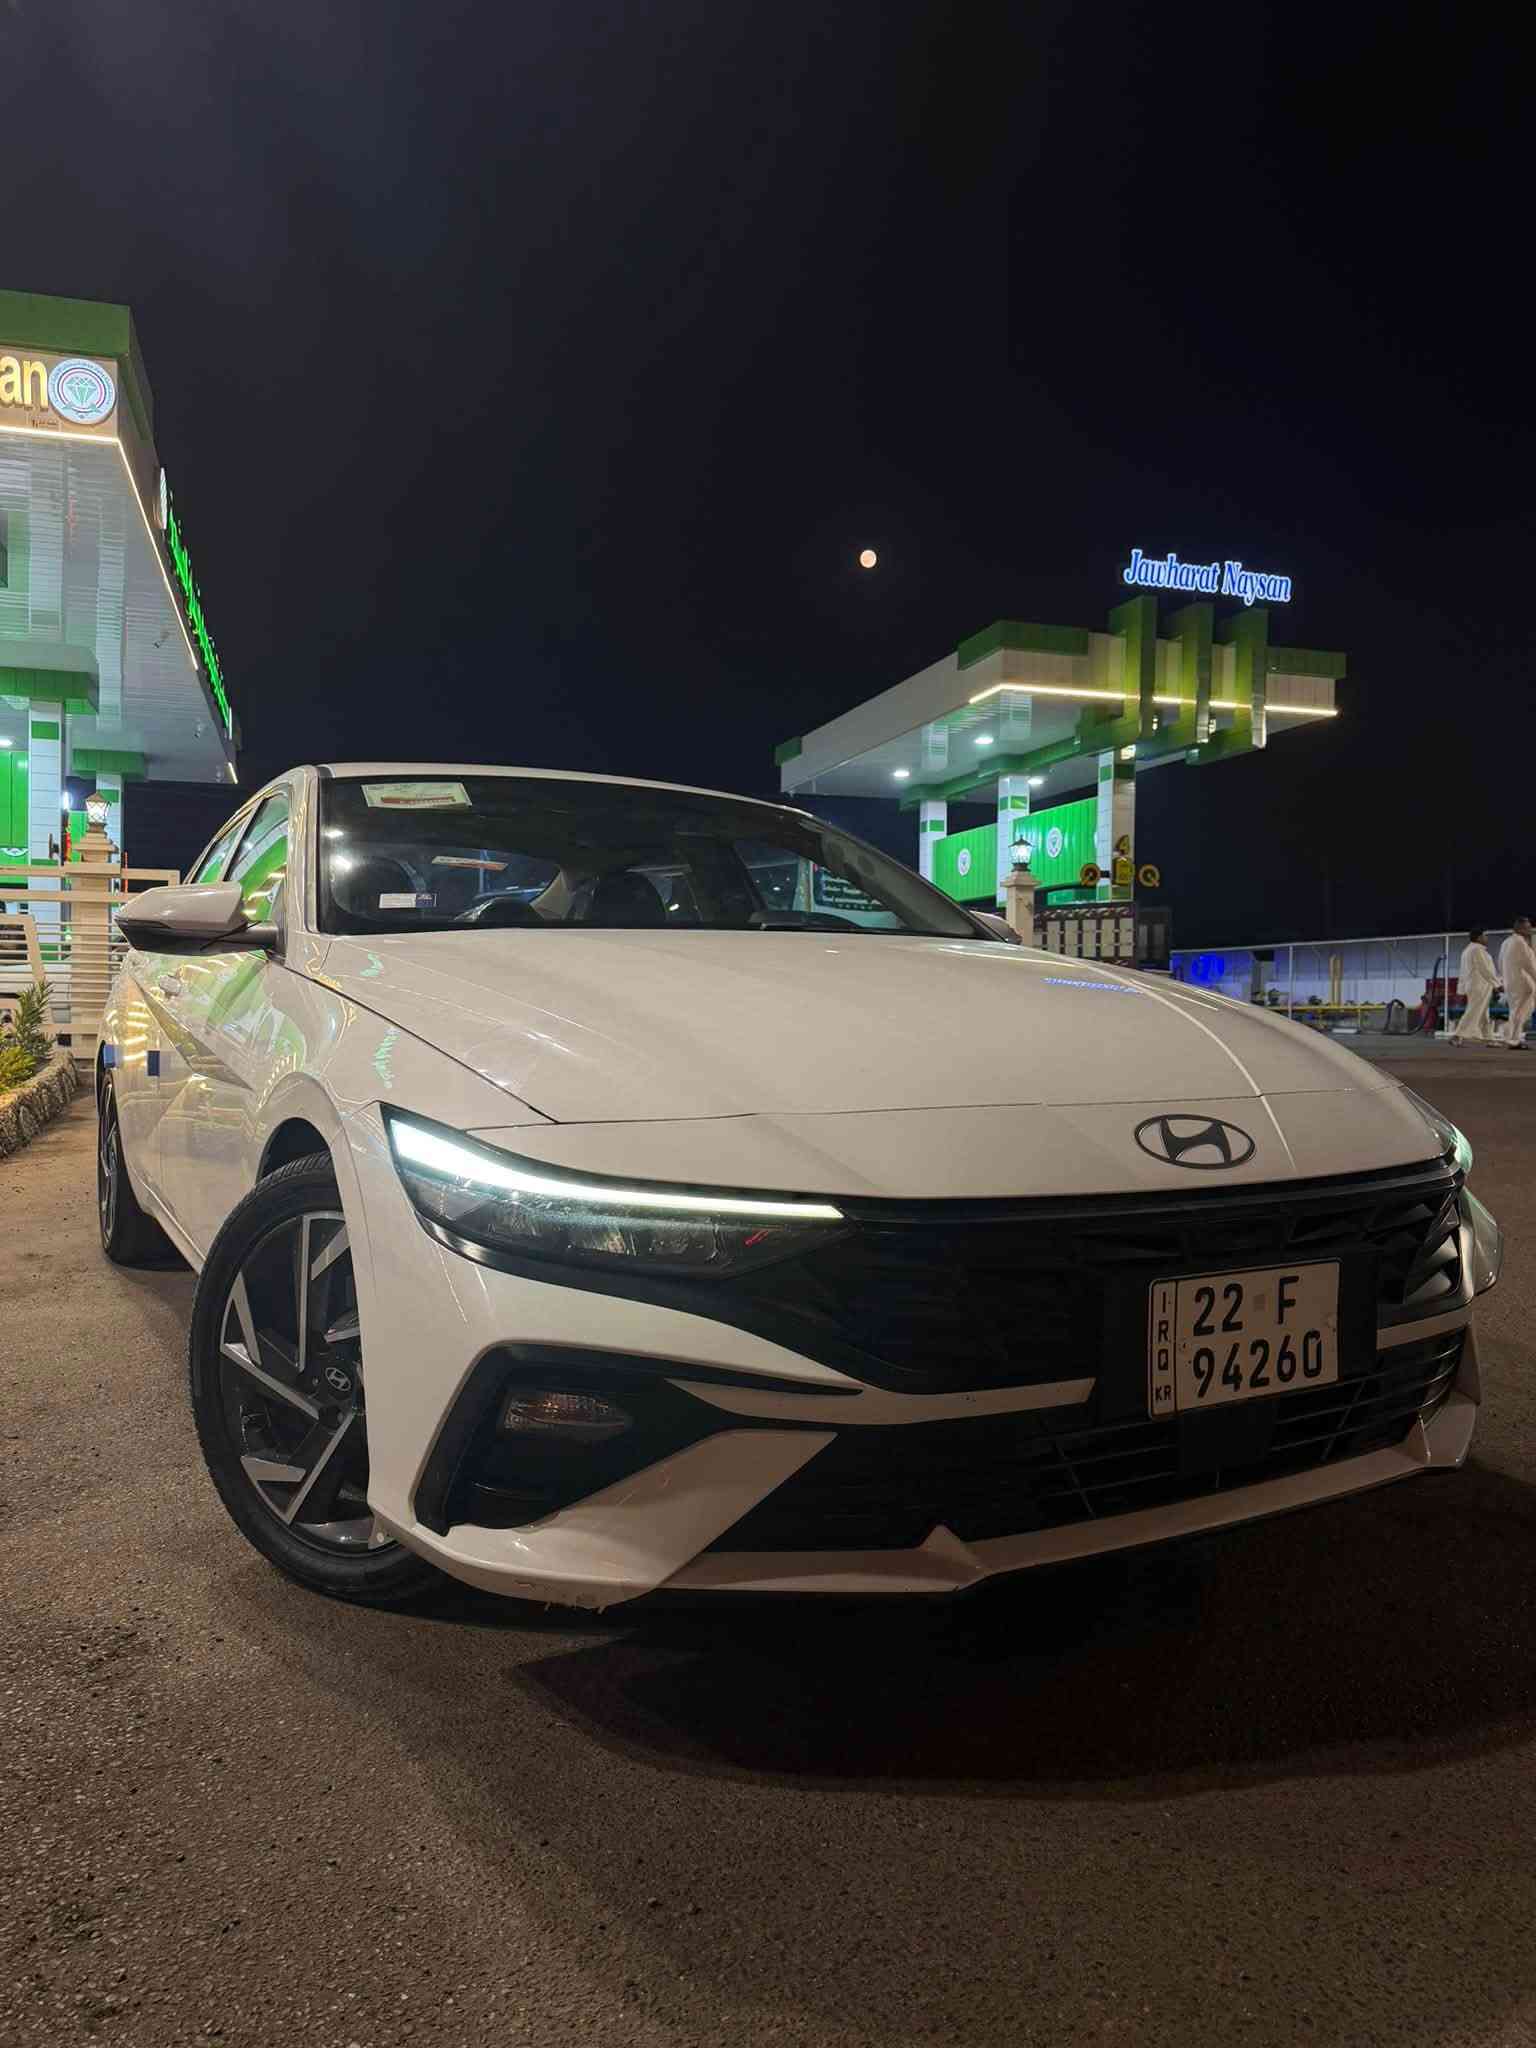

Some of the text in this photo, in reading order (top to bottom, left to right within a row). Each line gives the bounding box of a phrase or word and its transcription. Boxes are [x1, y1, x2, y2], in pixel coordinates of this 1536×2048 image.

[1123, 548, 1292, 606] Jawharat Naysan
[1193, 1275, 1299, 1337] 22 F
[1155, 1385, 1172, 1401] KR
[1193, 1330, 1322, 1398] 94260
